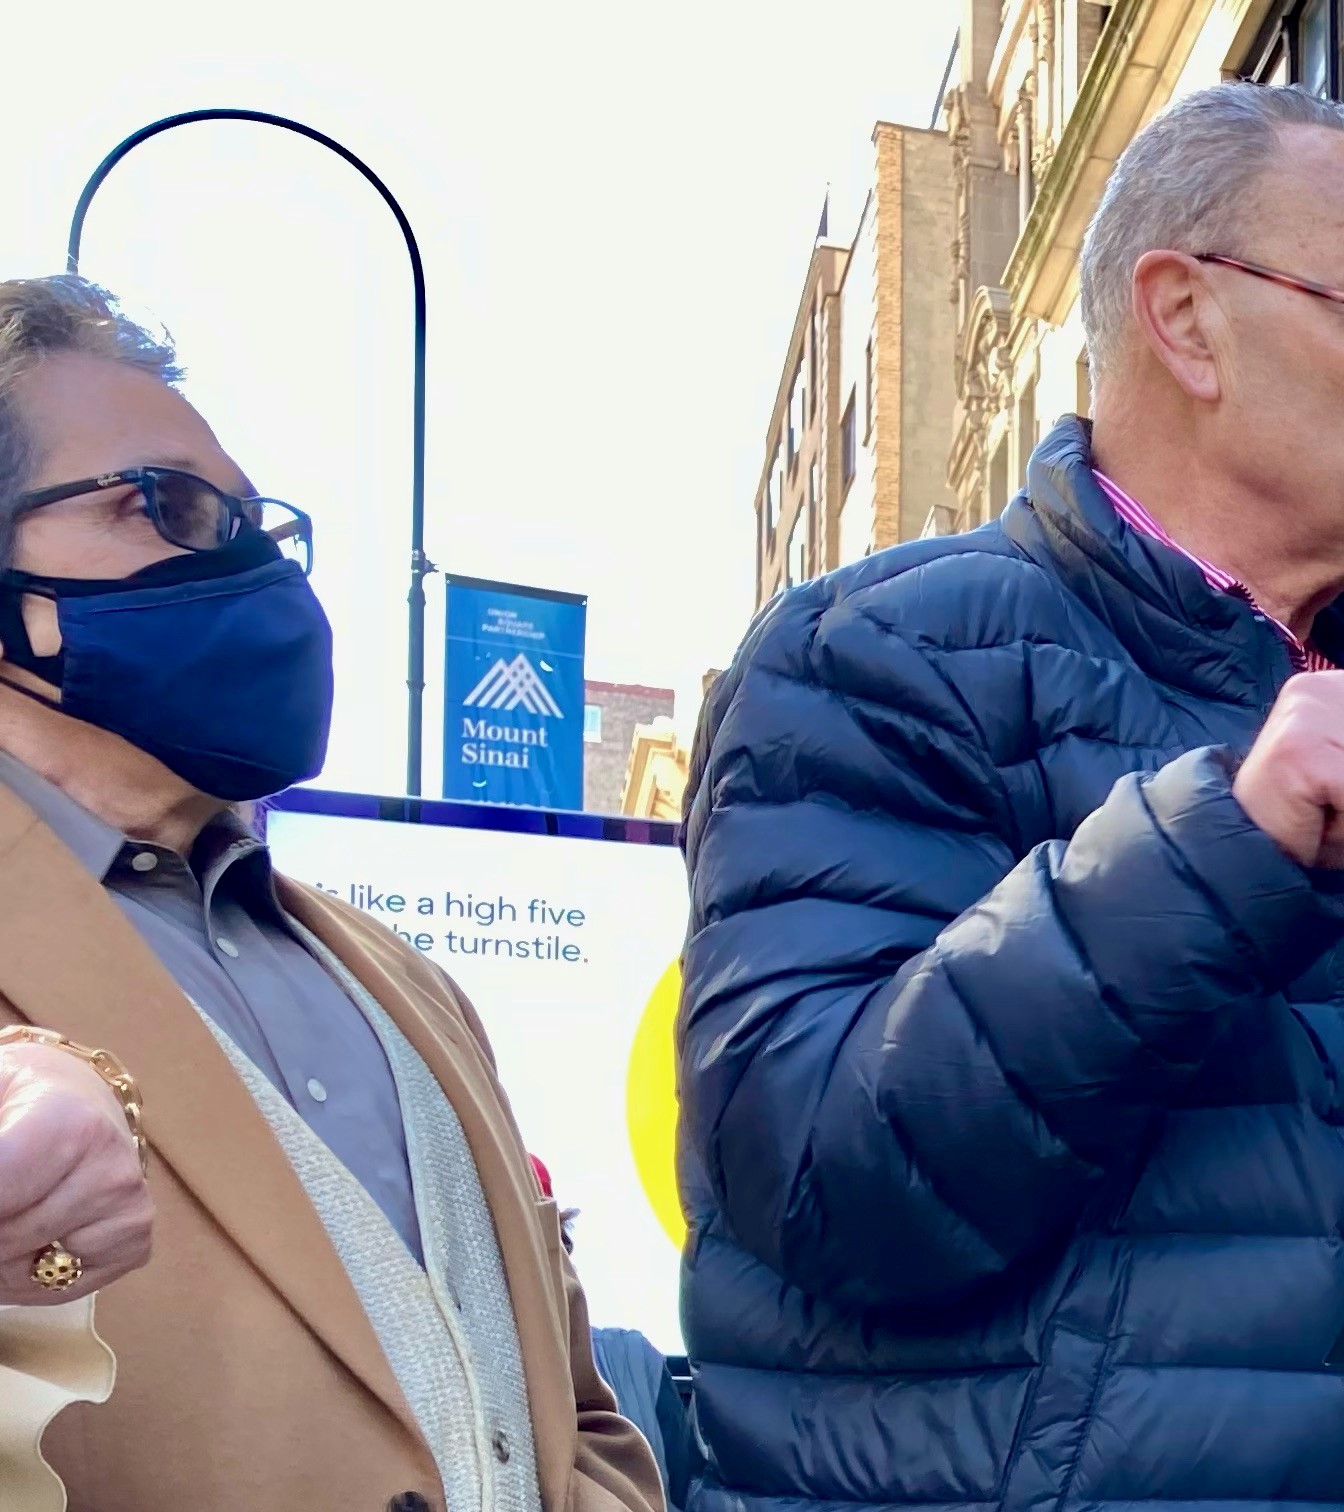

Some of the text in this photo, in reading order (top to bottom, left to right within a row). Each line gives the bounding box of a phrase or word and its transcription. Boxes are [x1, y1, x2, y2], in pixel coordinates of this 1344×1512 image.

[461, 717, 549, 748] Mount
[461, 743, 530, 770] Sinai
[350, 883, 407, 913] like
[417, 896, 434, 915] a
[446, 891, 517, 926] high
[528, 898, 586, 927] five
[445, 930, 589, 964] turnstile.
